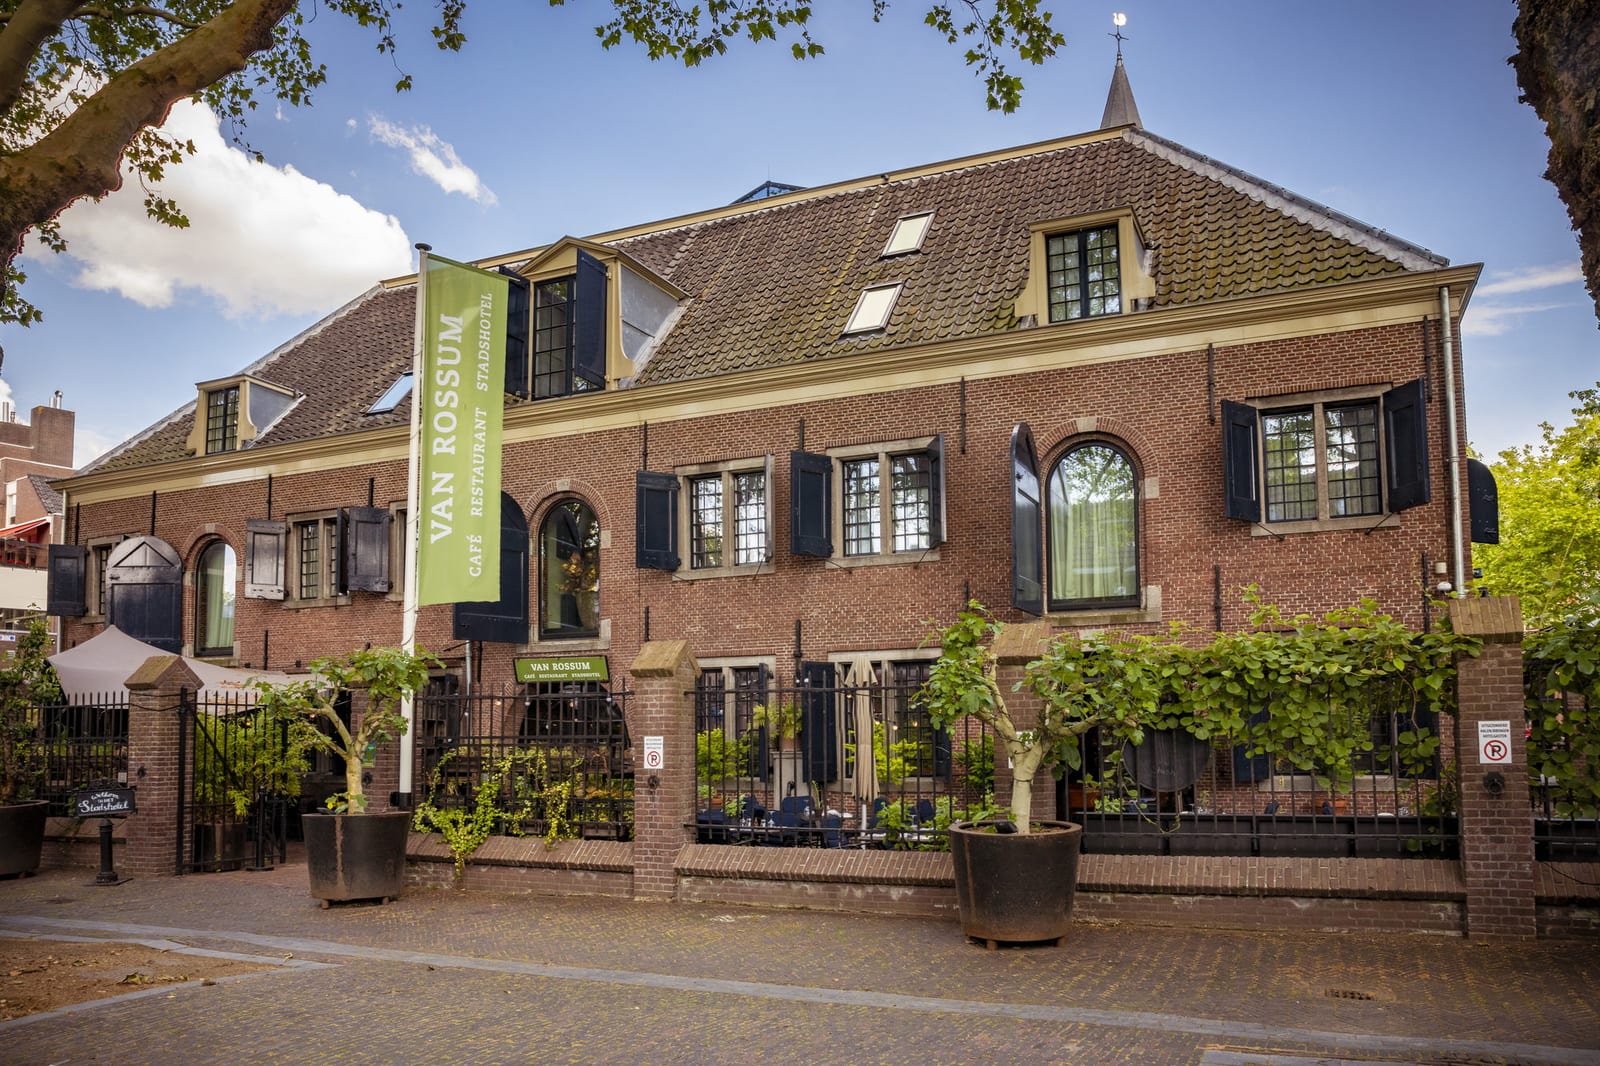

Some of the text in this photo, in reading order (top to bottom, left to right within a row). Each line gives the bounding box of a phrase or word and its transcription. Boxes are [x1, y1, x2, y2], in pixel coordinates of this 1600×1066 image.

[430, 313, 464, 545] VAN ROSSUM
[468, 292, 494, 578] CAFÉ RESTAURANT STADSHOTEL
[530, 662, 591, 672] VAN ROSSUM
[78, 800, 129, 813] Stadshotel
